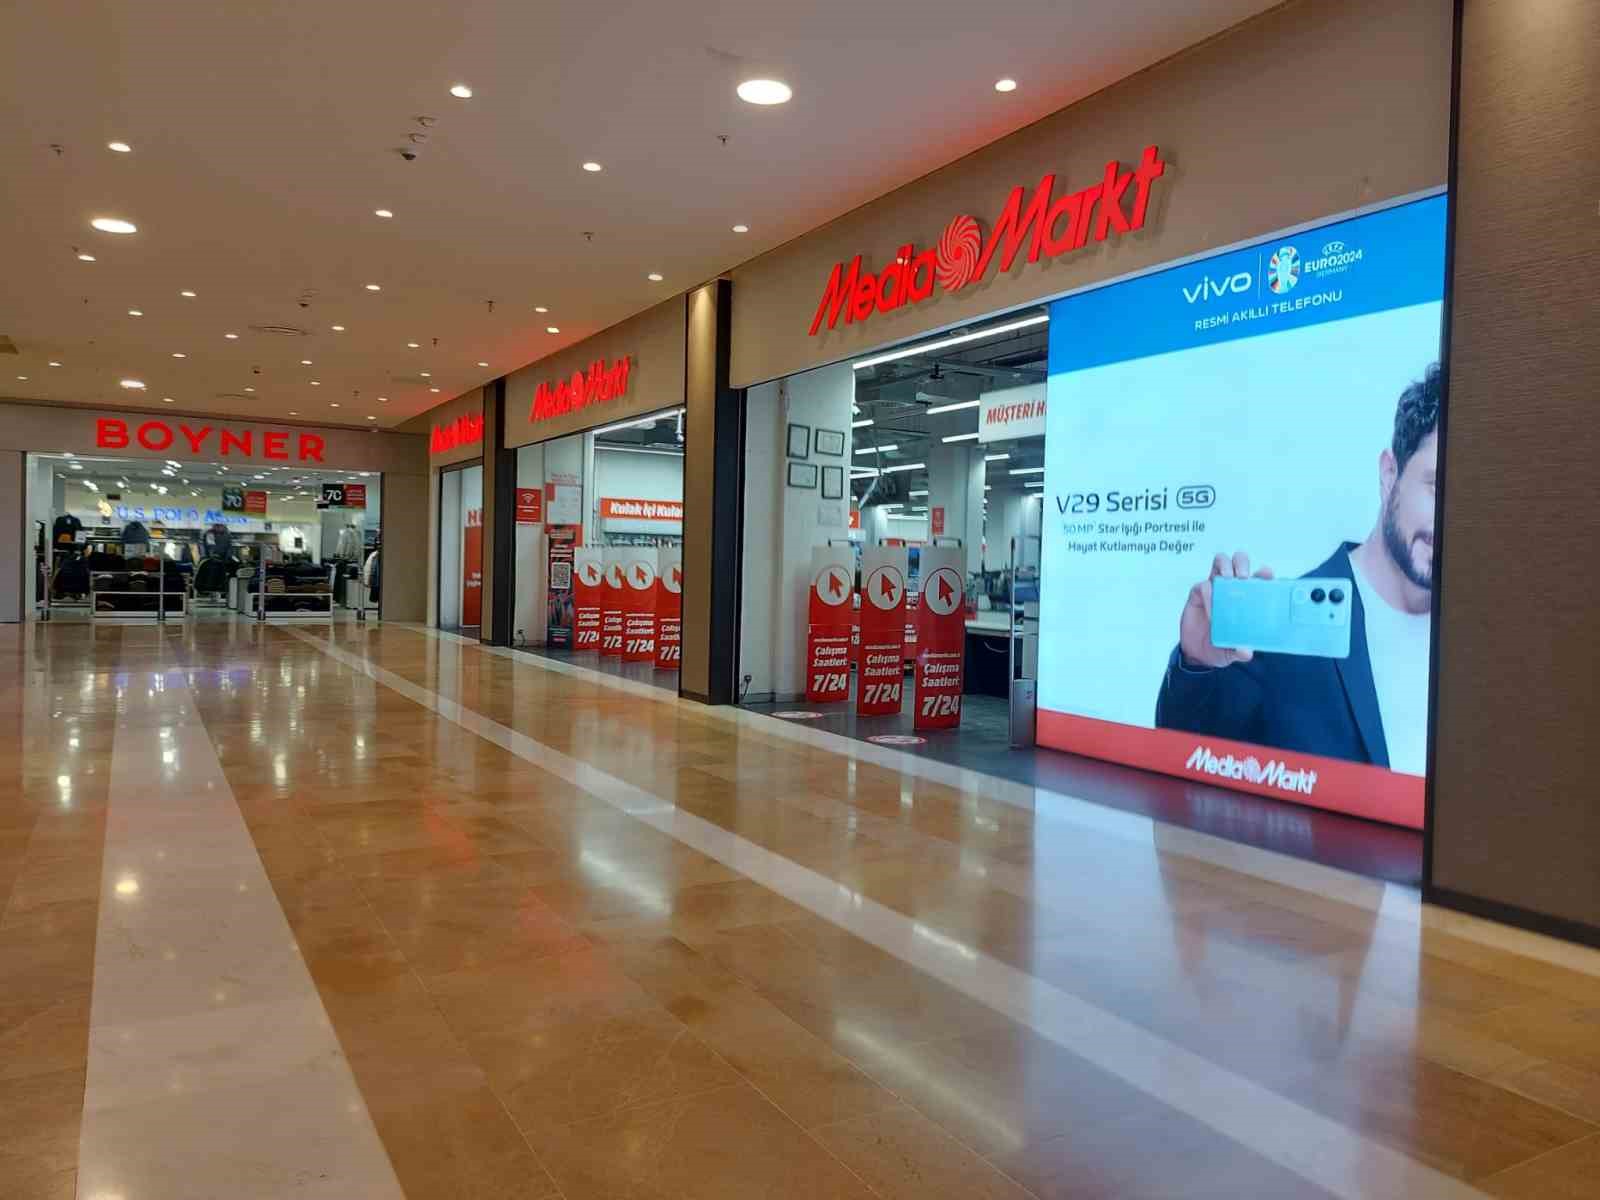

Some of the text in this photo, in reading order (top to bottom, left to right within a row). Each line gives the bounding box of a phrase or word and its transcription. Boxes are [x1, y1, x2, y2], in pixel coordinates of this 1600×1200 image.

[808, 144, 1165, 336] Media Markt
[1182, 272, 1252, 304] vivo
[1271, 290, 1343, 315] TELEFONU
[96, 418, 326, 463] BOYNER
[1056, 488, 1209, 515] V29 Serisi 5G
[626, 639, 655, 654] 7/24
[813, 673, 848, 693] 7/24
[864, 683, 900, 705] 7/24
[922, 695, 960, 718] 7/24
